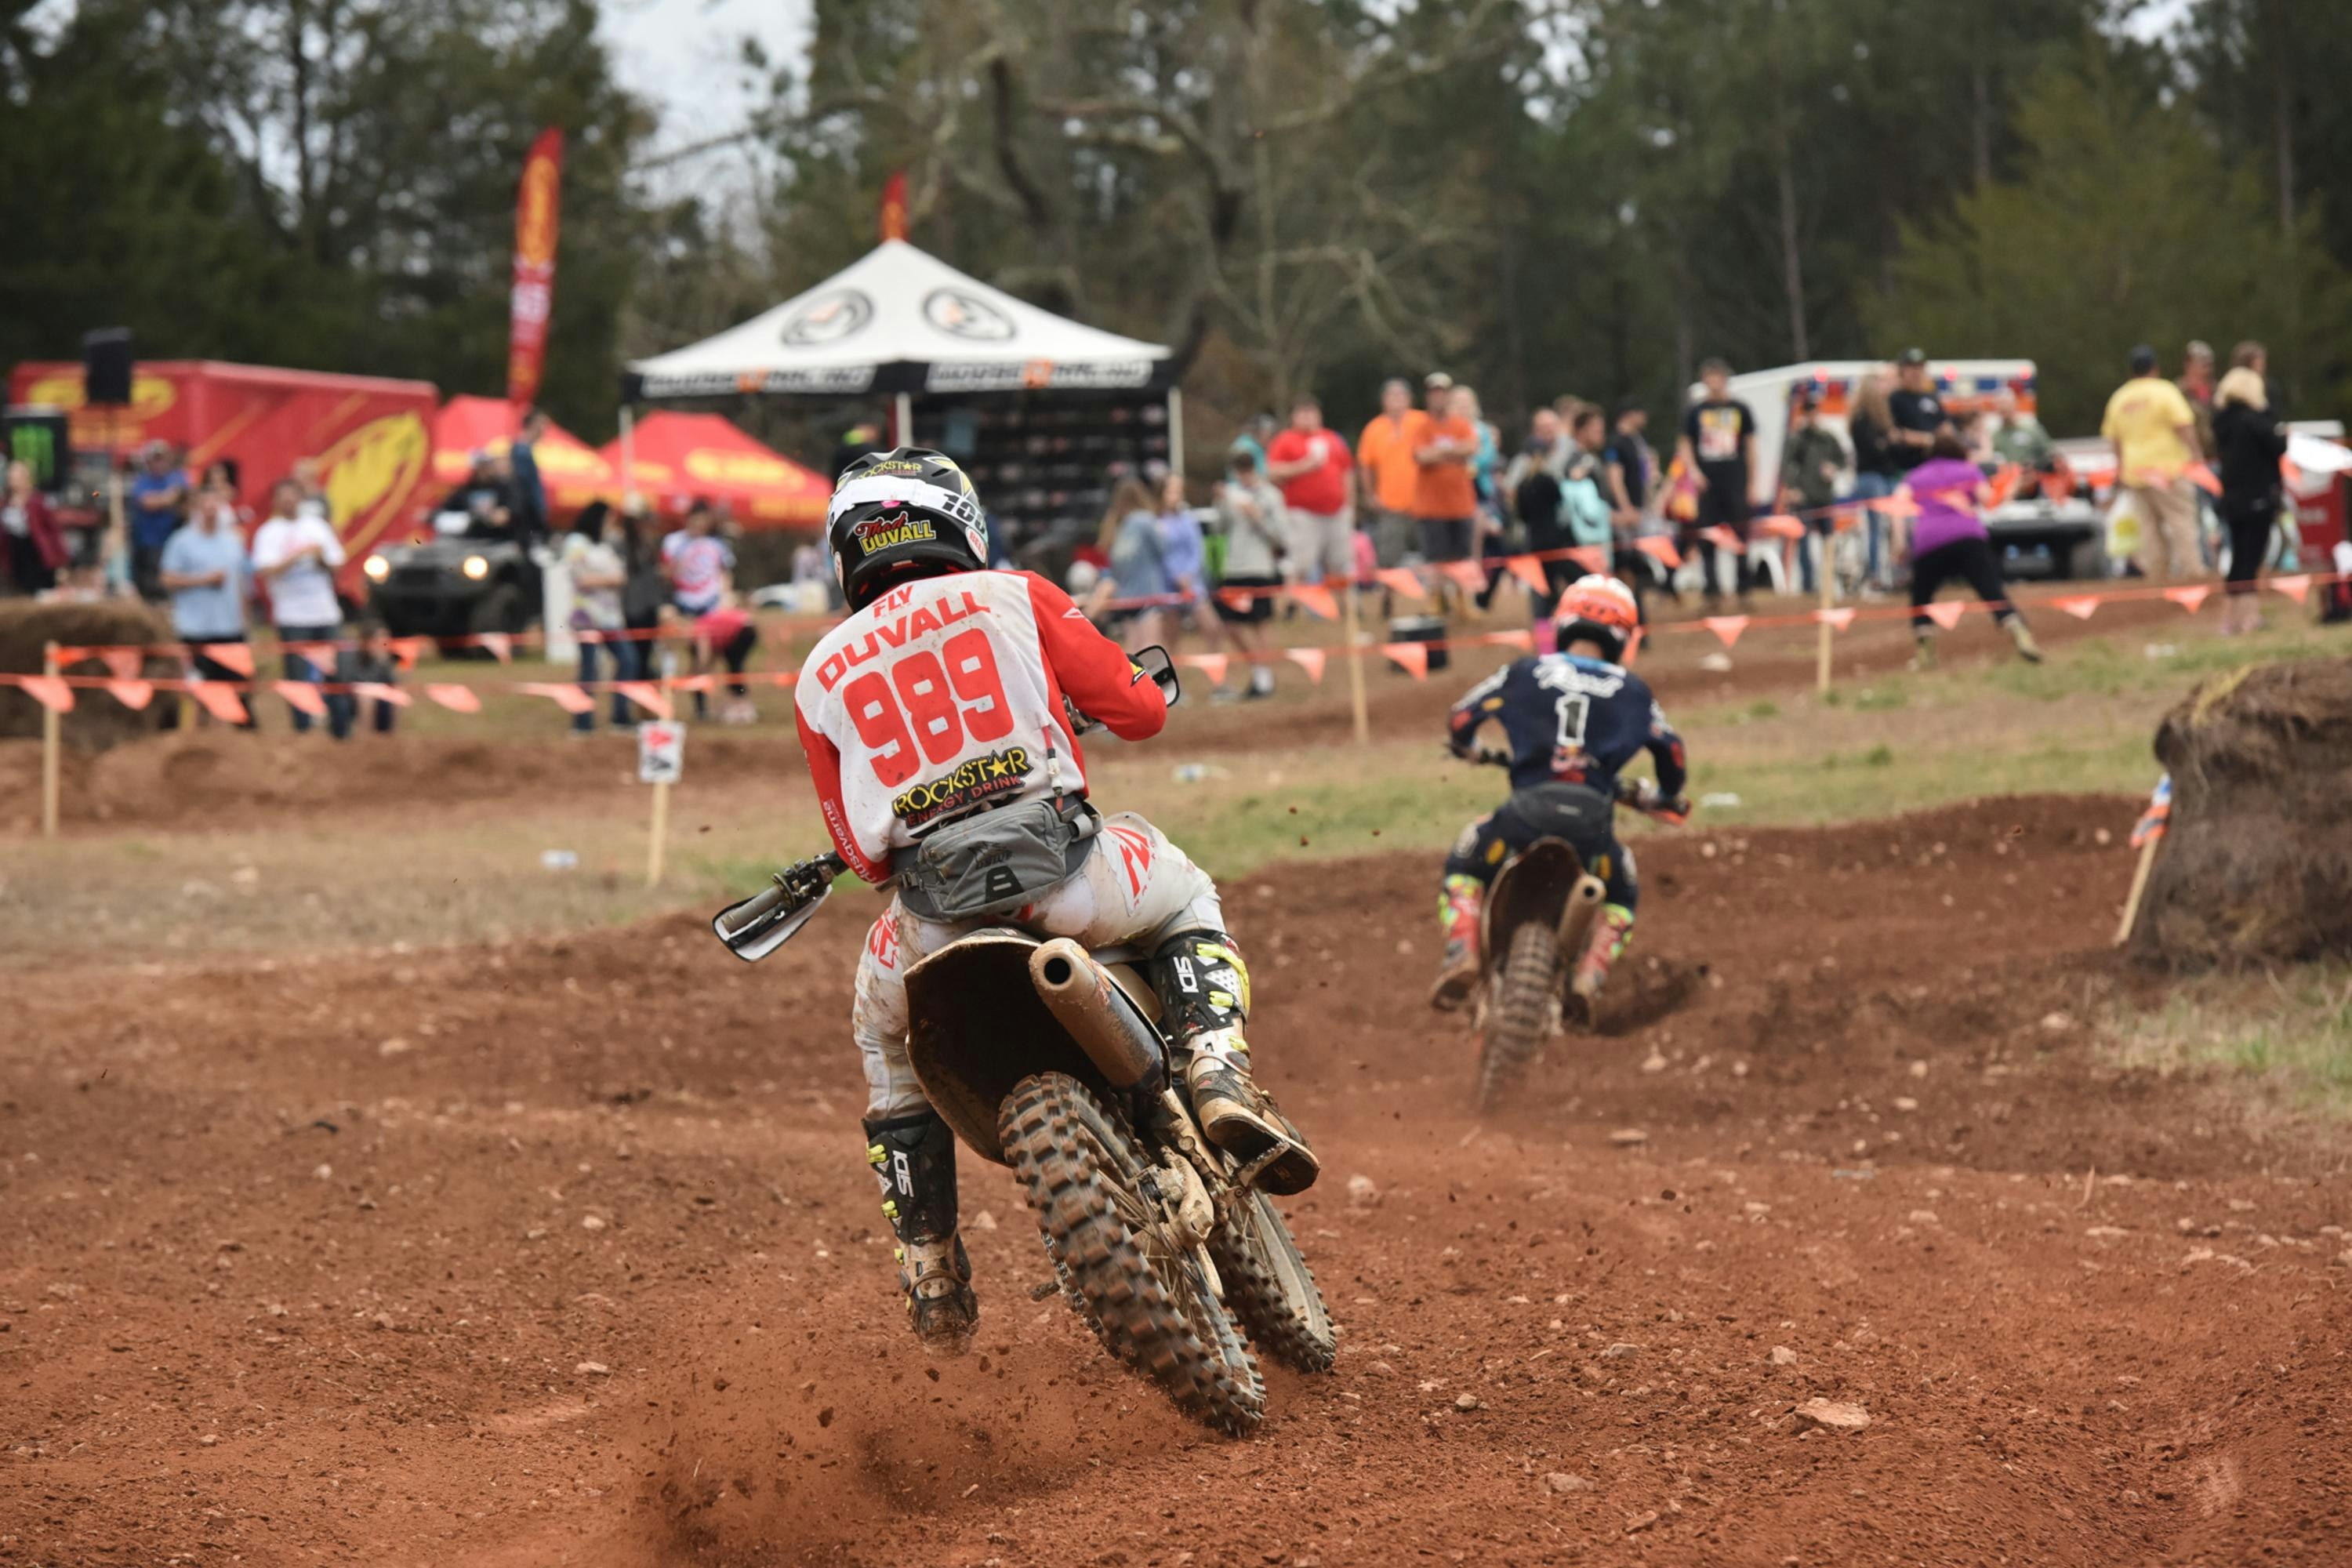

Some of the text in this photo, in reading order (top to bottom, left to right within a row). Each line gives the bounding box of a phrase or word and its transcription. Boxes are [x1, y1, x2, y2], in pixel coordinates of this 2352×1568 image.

[861, 521, 935, 554] DUVALL
[872, 585, 913, 619] FLY
[815, 591, 991, 693] DUVALL
[843, 628, 1014, 788] 989
[1555, 693, 1590, 746] 1
[971, 775, 1022, 798] DRINK
[823, 800, 877, 883] Husqvarna
